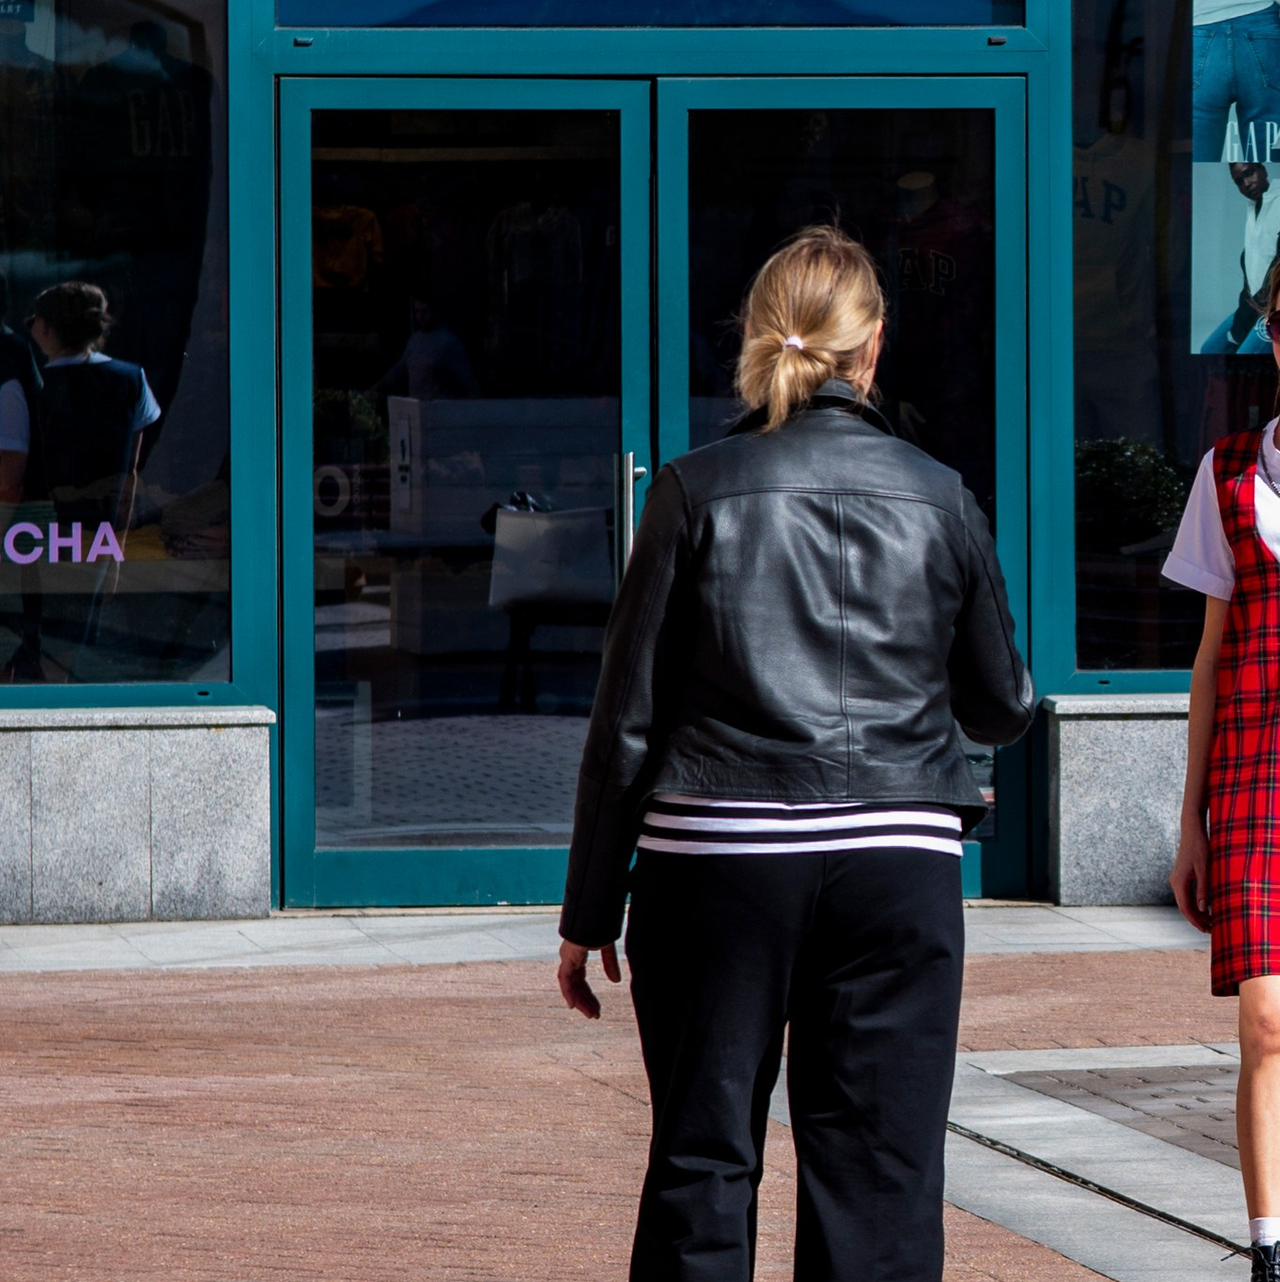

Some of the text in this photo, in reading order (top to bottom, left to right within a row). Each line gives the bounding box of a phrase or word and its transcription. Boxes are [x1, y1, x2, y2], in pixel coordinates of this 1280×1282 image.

[127, 88, 197, 158] GAP
[1226, 121, 1278, 164] GAP
[1073, 175, 1127, 224] AP
[897, 247, 957, 297] AP
[0, 521, 125, 565] СНА
